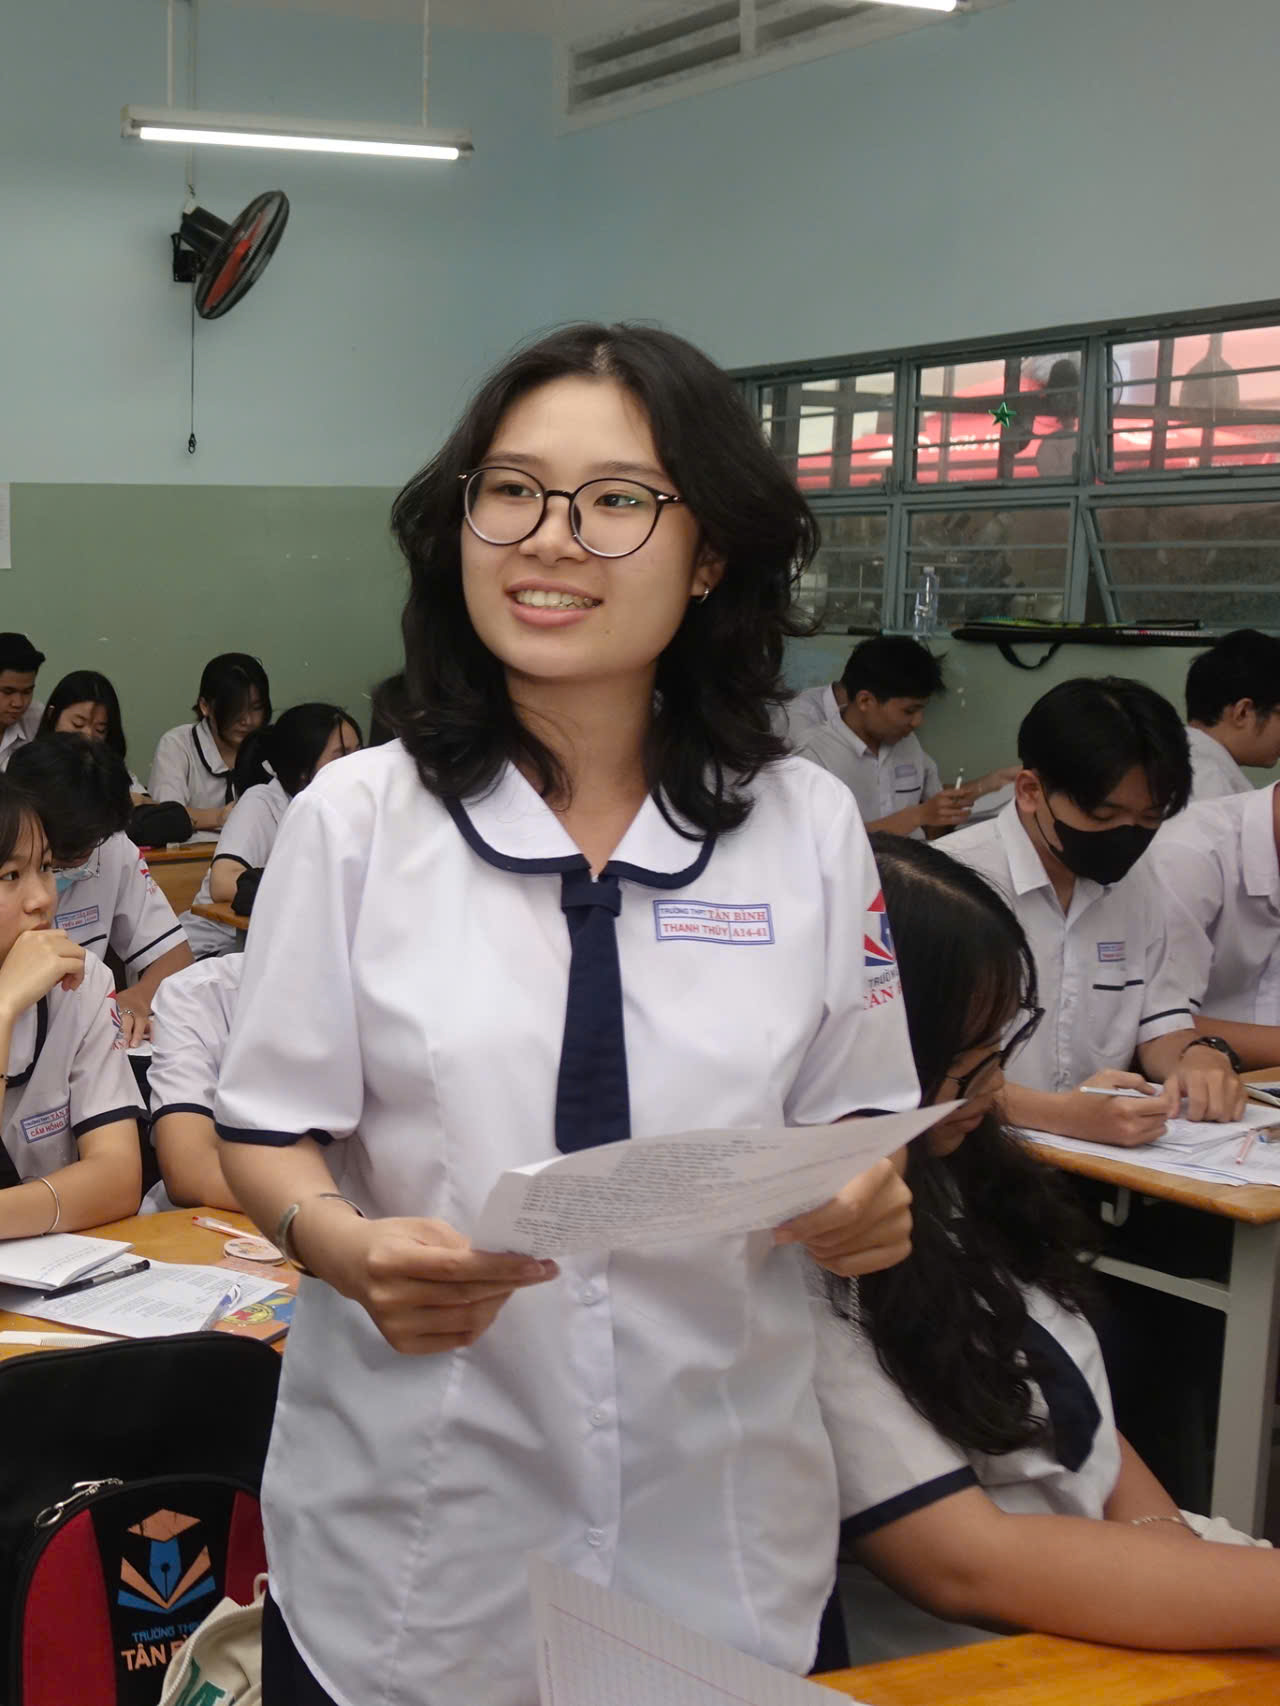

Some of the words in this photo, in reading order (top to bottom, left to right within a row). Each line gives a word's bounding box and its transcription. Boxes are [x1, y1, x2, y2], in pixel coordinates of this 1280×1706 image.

[707, 907, 730, 921] TÂN
[663, 922, 700, 935] THANH
[121, 1642, 168, 1672] TÂN
